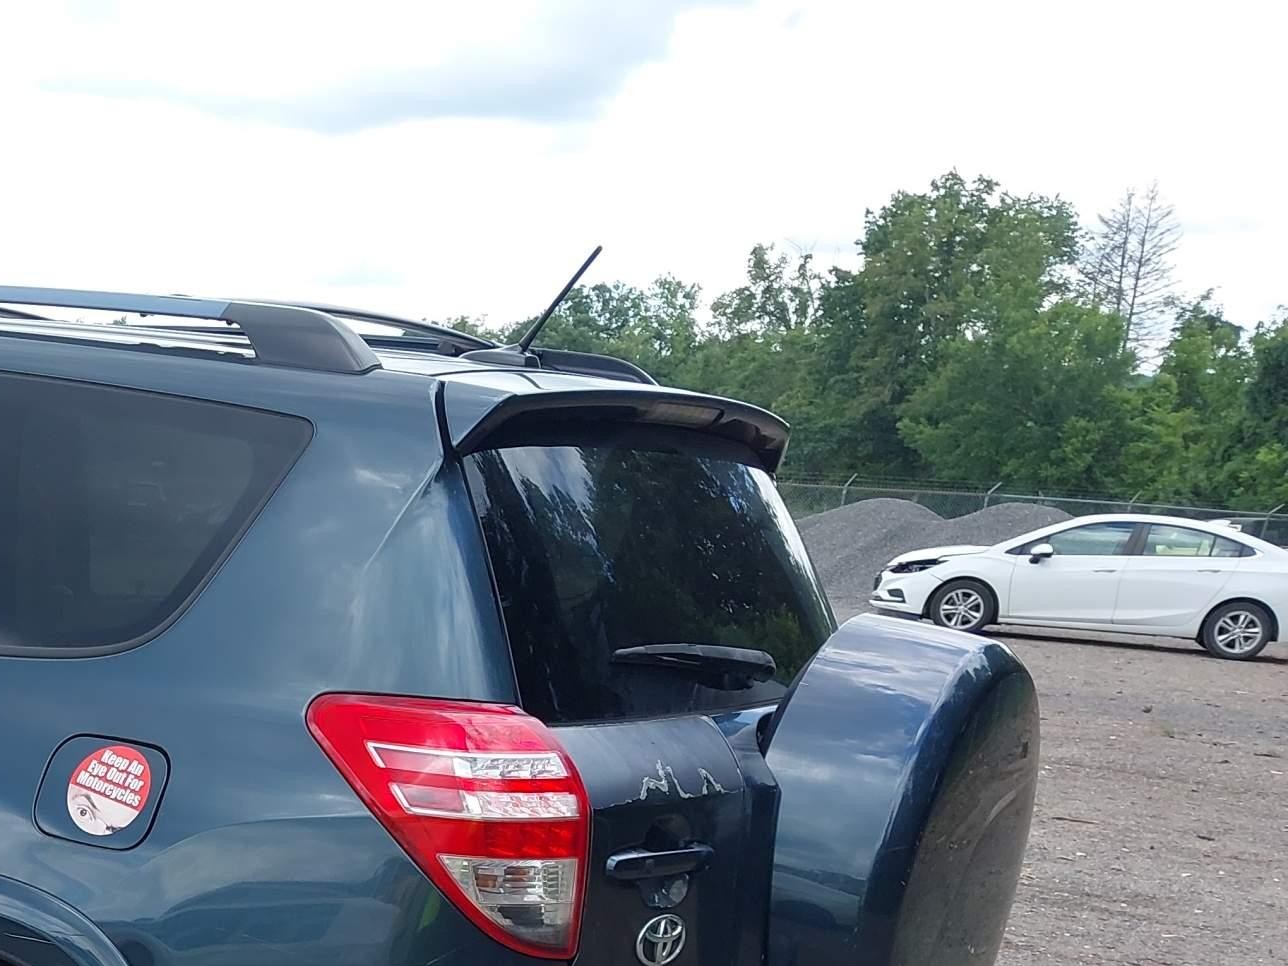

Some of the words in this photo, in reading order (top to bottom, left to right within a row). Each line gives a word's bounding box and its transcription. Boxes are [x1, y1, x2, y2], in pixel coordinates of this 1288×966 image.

[87, 759, 108, 776] Eye
[106, 767, 127, 784] Out
[124, 775, 145, 791] For
[101, 749, 129, 771] Keep
[127, 759, 144, 776] An
[76, 770, 141, 807] Motorcycles
